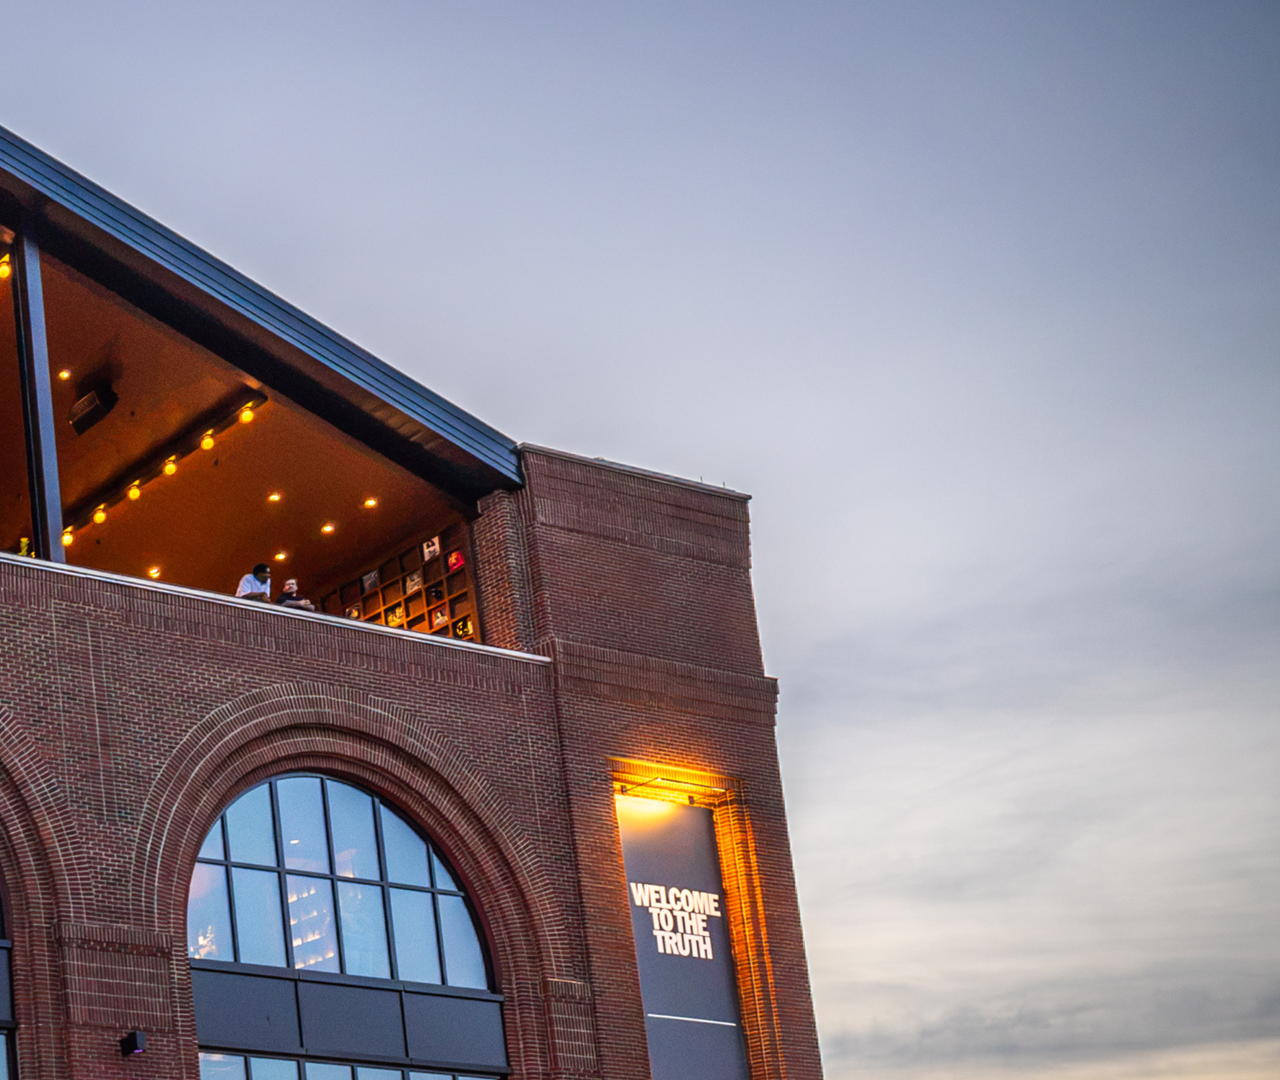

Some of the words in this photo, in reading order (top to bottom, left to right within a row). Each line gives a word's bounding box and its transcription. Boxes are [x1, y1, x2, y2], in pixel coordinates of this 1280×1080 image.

[630, 882, 721, 917] WELCOME
[649, 906, 673, 933] TO
[673, 909, 710, 937] THE
[653, 929, 714, 960] TRUTH
